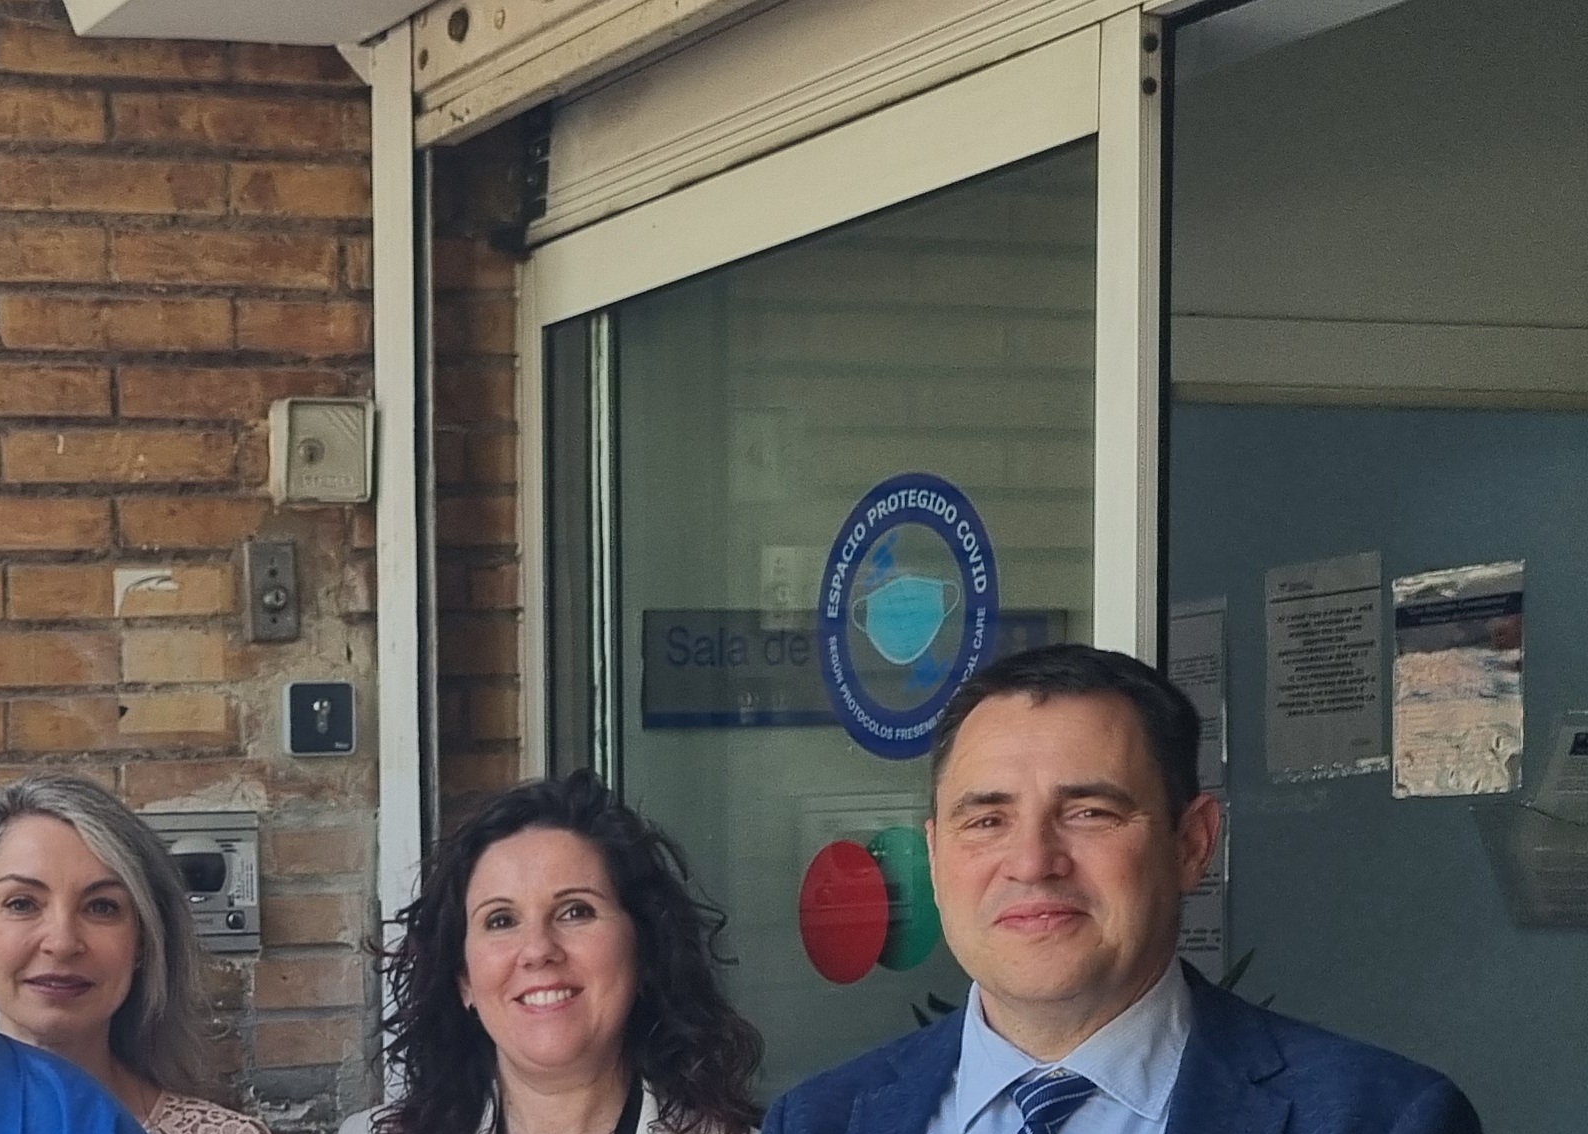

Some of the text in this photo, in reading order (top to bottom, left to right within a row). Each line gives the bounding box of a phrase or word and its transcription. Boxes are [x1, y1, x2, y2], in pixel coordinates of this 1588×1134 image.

[827, 489, 988, 618] ESPACIO PROTEGIDO COVID
[667, 625, 810, 668] Sala de
[840, 683, 893, 740] PROTOCOLOS
[974, 606, 986, 649] CARE
